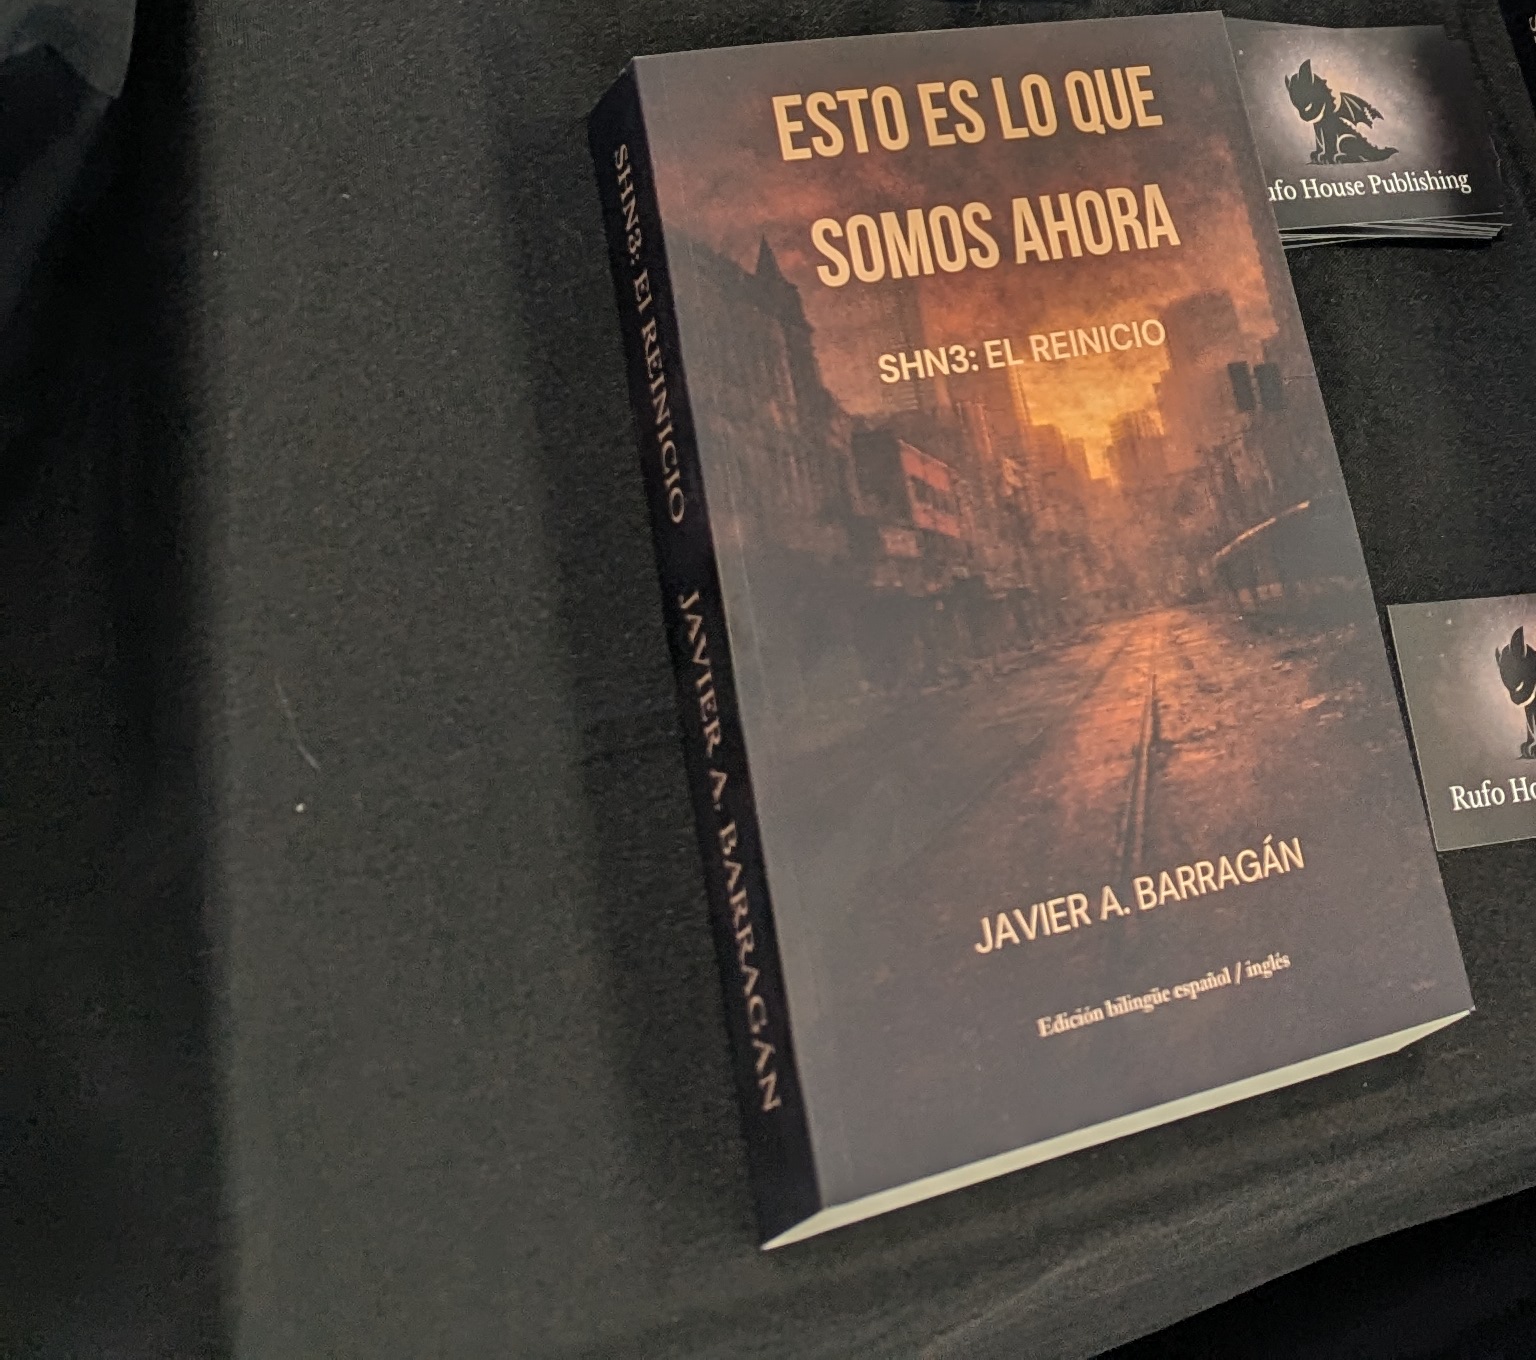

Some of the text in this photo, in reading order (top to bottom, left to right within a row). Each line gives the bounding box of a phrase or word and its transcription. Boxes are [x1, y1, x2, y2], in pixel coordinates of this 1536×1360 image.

[771, 65, 1163, 161] ESTO ES LO QUE
[810, 183, 1182, 288] SOMOS AHORA
[878, 318, 1167, 384] SHN3: EL REINICIO
[1449, 780, 1505, 811] Rufo
[974, 834, 1305, 955] JAVIER A. BARRAGÁN
